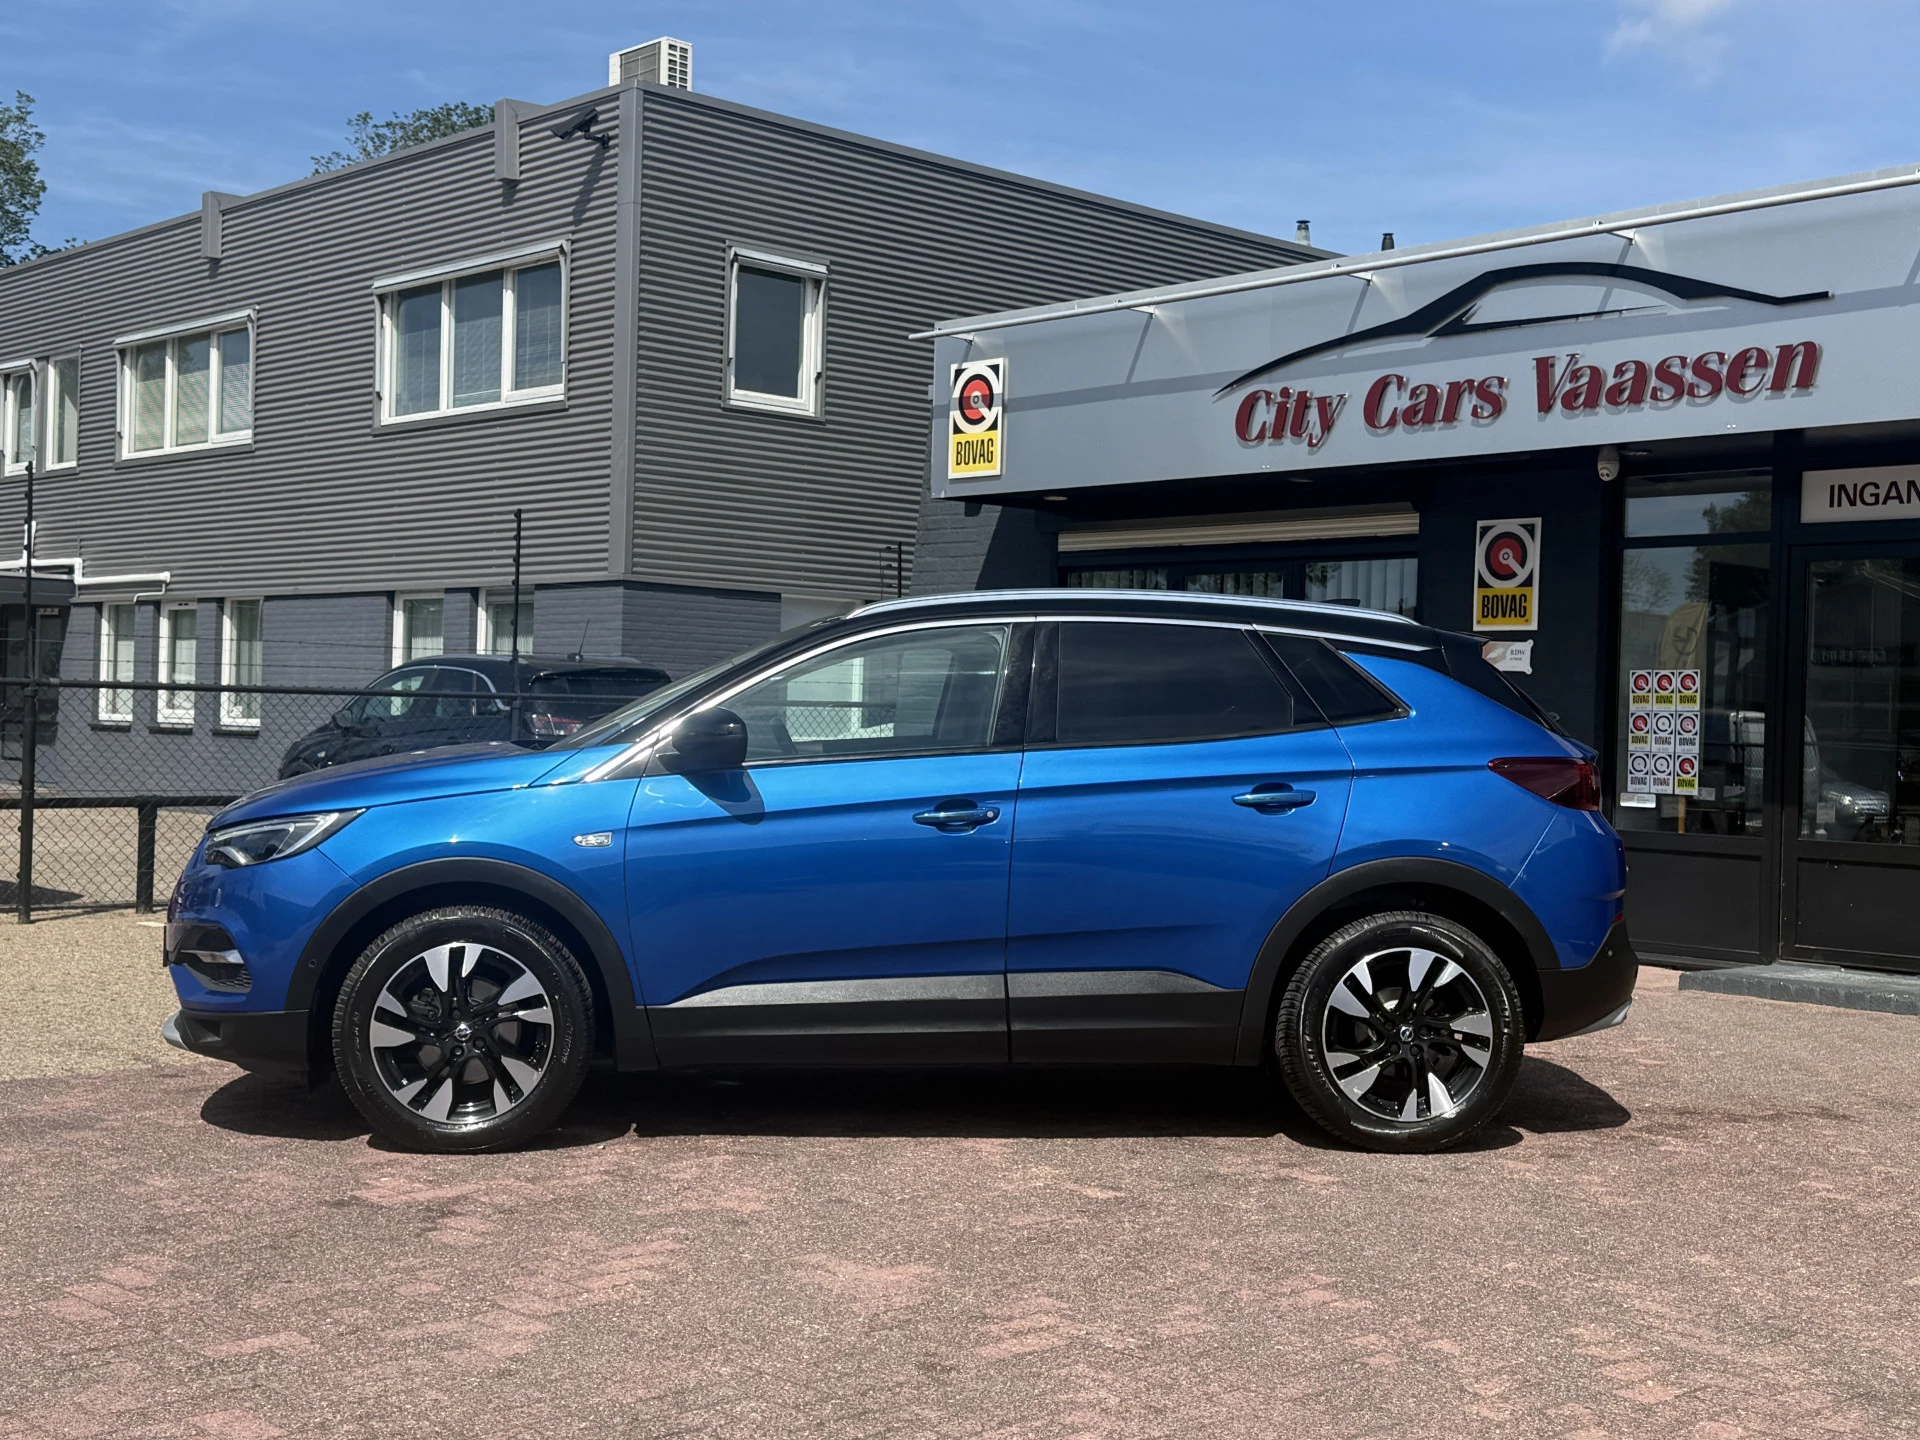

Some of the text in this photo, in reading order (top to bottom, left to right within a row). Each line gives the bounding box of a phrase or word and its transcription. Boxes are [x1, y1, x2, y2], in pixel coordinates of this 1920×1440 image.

[1235, 339, 1819, 448] City Cars Vaassen
[955, 438, 994, 466] BOVAG
[1482, 594, 1527, 618] BOVAG
[1510, 648, 1526, 656] RDW
[1632, 694, 1650, 704] BOVAG
[1655, 695, 1673, 704] BOVAG
[1679, 694, 1697, 704] BOVAG
[1631, 735, 1648, 744] BOVAG
[1654, 735, 1672, 746] BOVAG
[1678, 736, 1696, 747] BOVAG
[1630, 775, 1648, 785] BOVAG
[1652, 776, 1670, 787] BOVAG
[1677, 778, 1695, 788] BOVAG
